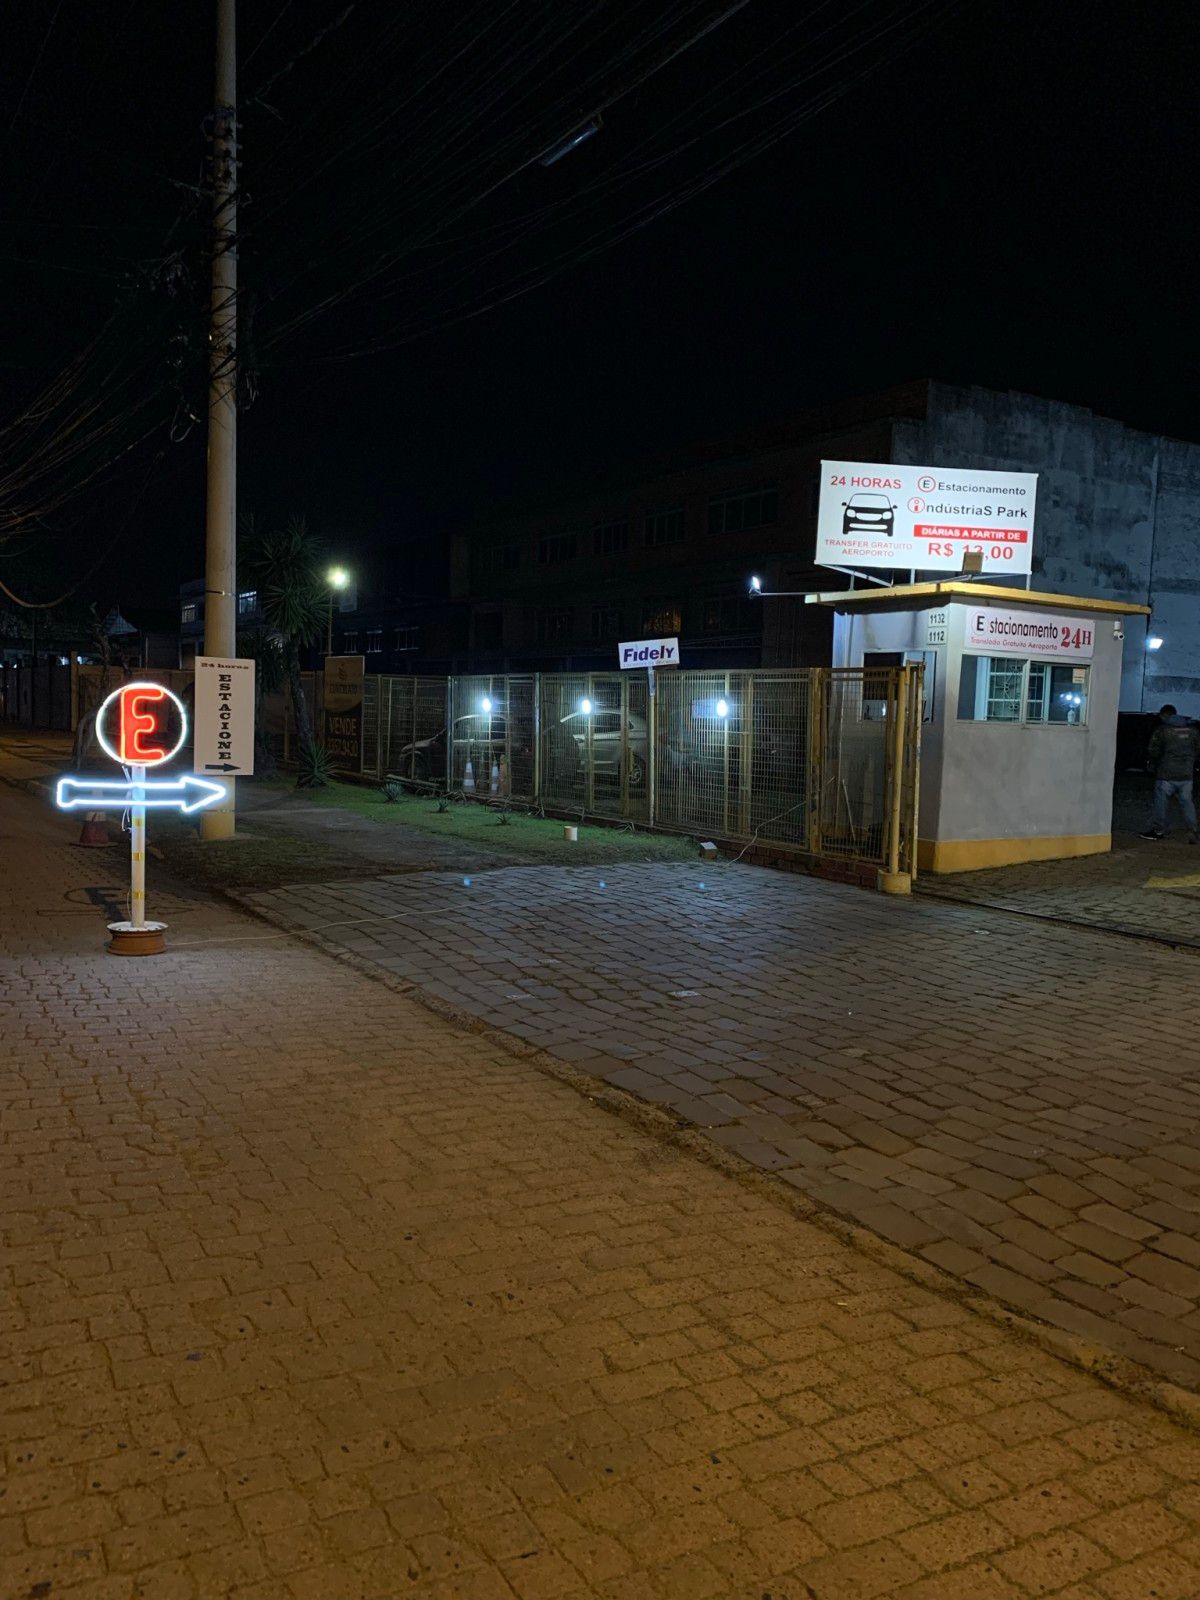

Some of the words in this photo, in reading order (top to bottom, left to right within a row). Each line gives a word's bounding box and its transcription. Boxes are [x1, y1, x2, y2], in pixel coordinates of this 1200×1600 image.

[830, 476, 847, 486] 24
[850, 477, 902, 489] HORAS
[937, 481, 1027, 496] Estacionamento
[997, 507, 1028, 518] Park
[921, 525, 961, 537] DIÁRIAS
[961, 529, 970, 537] A
[971, 530, 1007, 539] PARTIR
[1008, 532, 1021, 540] DE
[824, 539, 869, 548] TRANSFER
[870, 541, 913, 550] GRATUITO
[928, 542, 953, 558] R$
[841, 548, 895, 557] AEROPORTO
[930, 614, 945, 624] 1132
[928, 631, 945, 642] 1112
[1060, 626, 1092, 649] 24H
[1002, 639, 1027, 648] Gratuito
[1028, 641, 1058, 652] Aeroporto
[217, 674, 232, 760] ESTACIONE
[119, 687, 166, 762] E
[328, 717, 358, 737] VENDE
